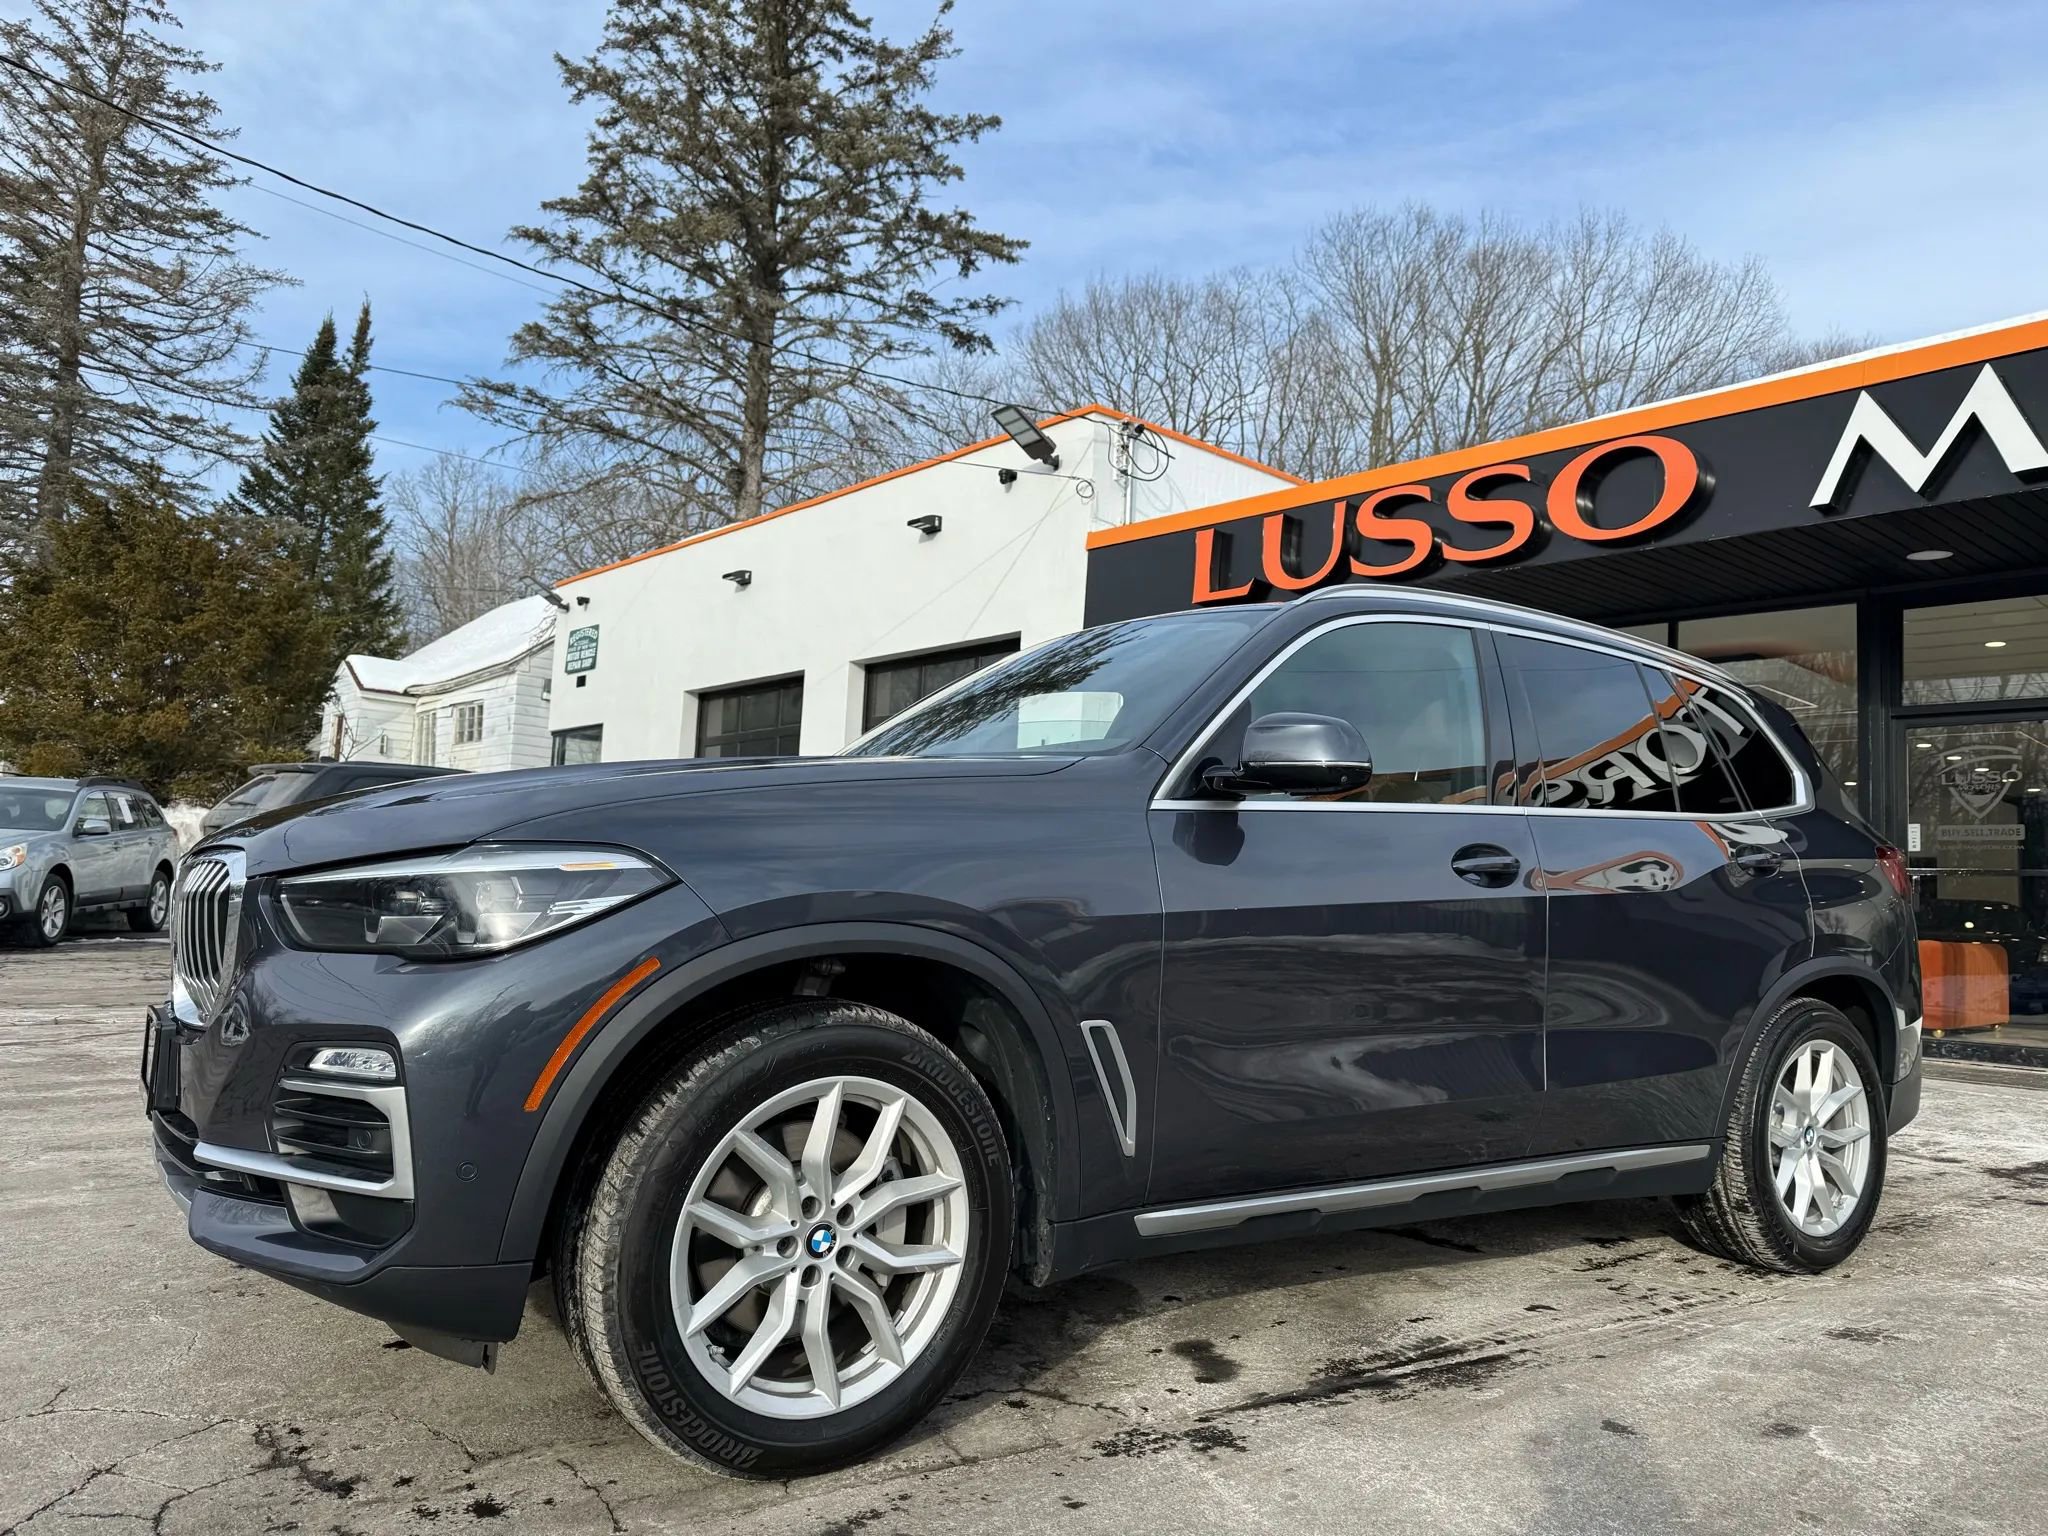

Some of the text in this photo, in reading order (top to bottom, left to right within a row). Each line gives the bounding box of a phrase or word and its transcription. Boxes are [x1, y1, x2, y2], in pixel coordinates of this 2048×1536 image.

[1192, 434, 1699, 605] LUSSO
[581, 657, 593, 668] SHOP
[1941, 769, 2023, 785] LUSSO
[637, 1341, 765, 1469] BRIDGESTONE
